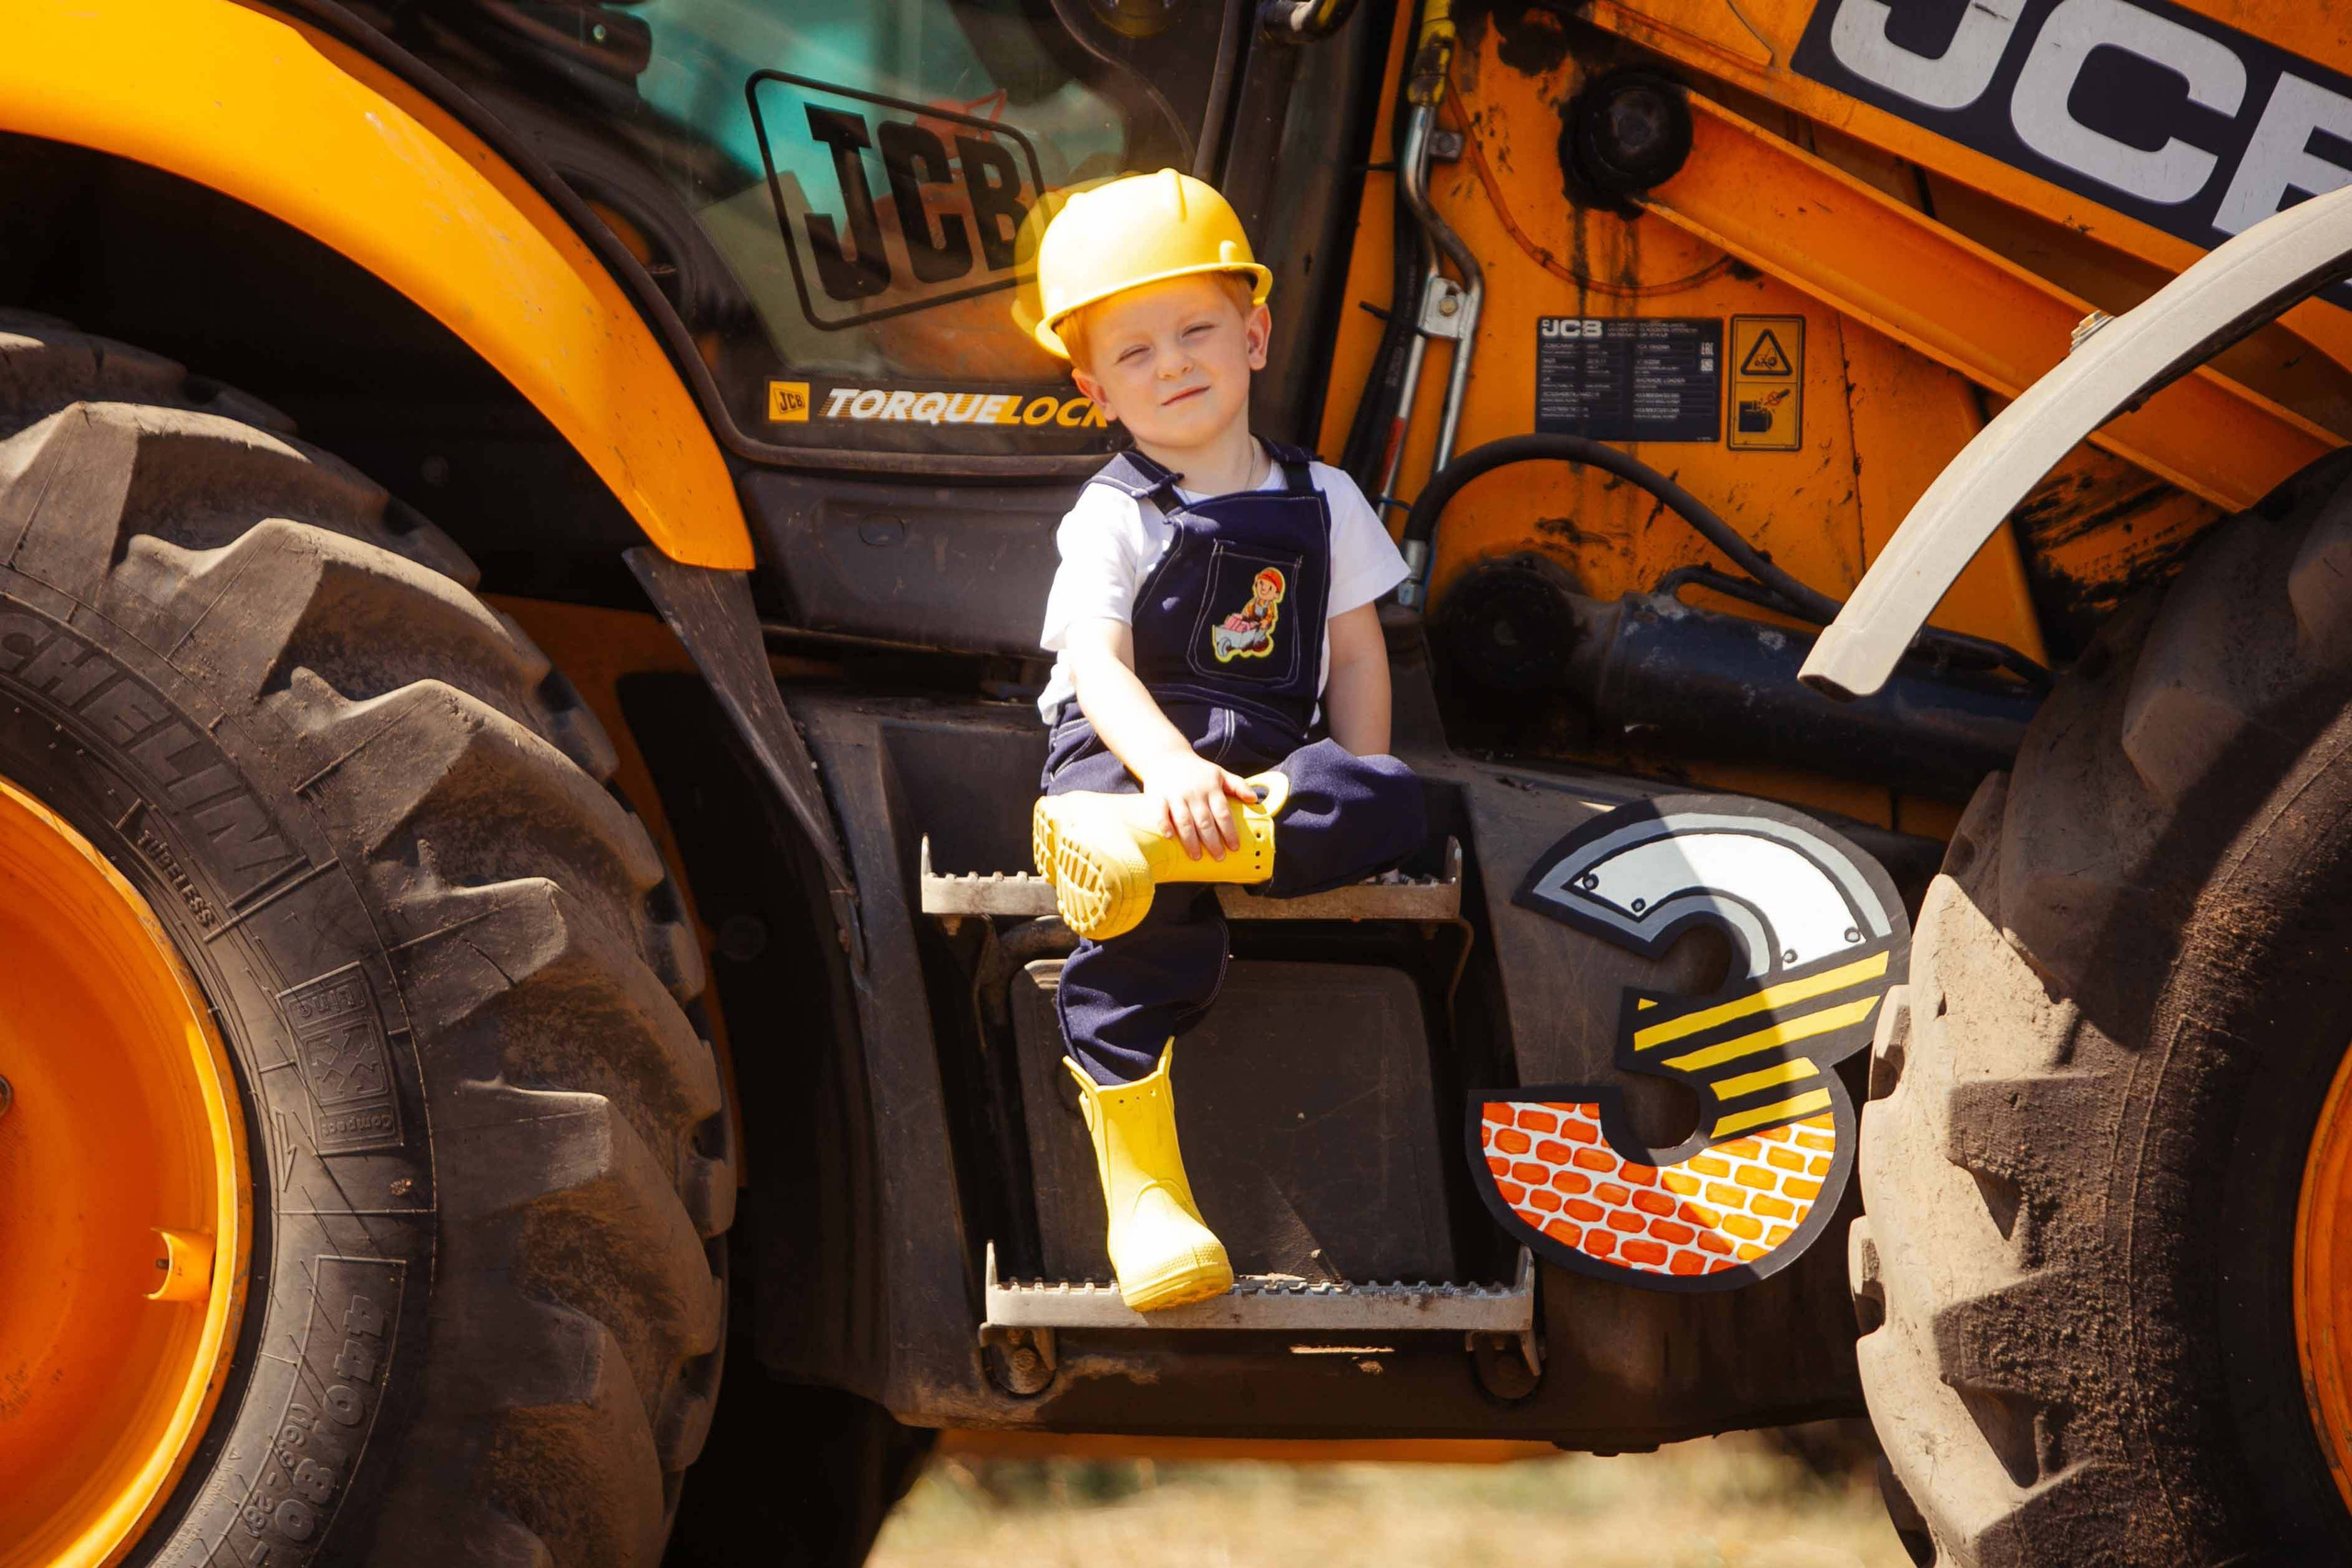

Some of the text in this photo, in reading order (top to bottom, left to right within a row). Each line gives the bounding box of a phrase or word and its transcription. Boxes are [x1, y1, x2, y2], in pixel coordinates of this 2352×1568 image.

[803, 101, 1036, 301] JCB
[1542, 319, 1602, 337] JCB
[779, 392, 805, 413] JCB
